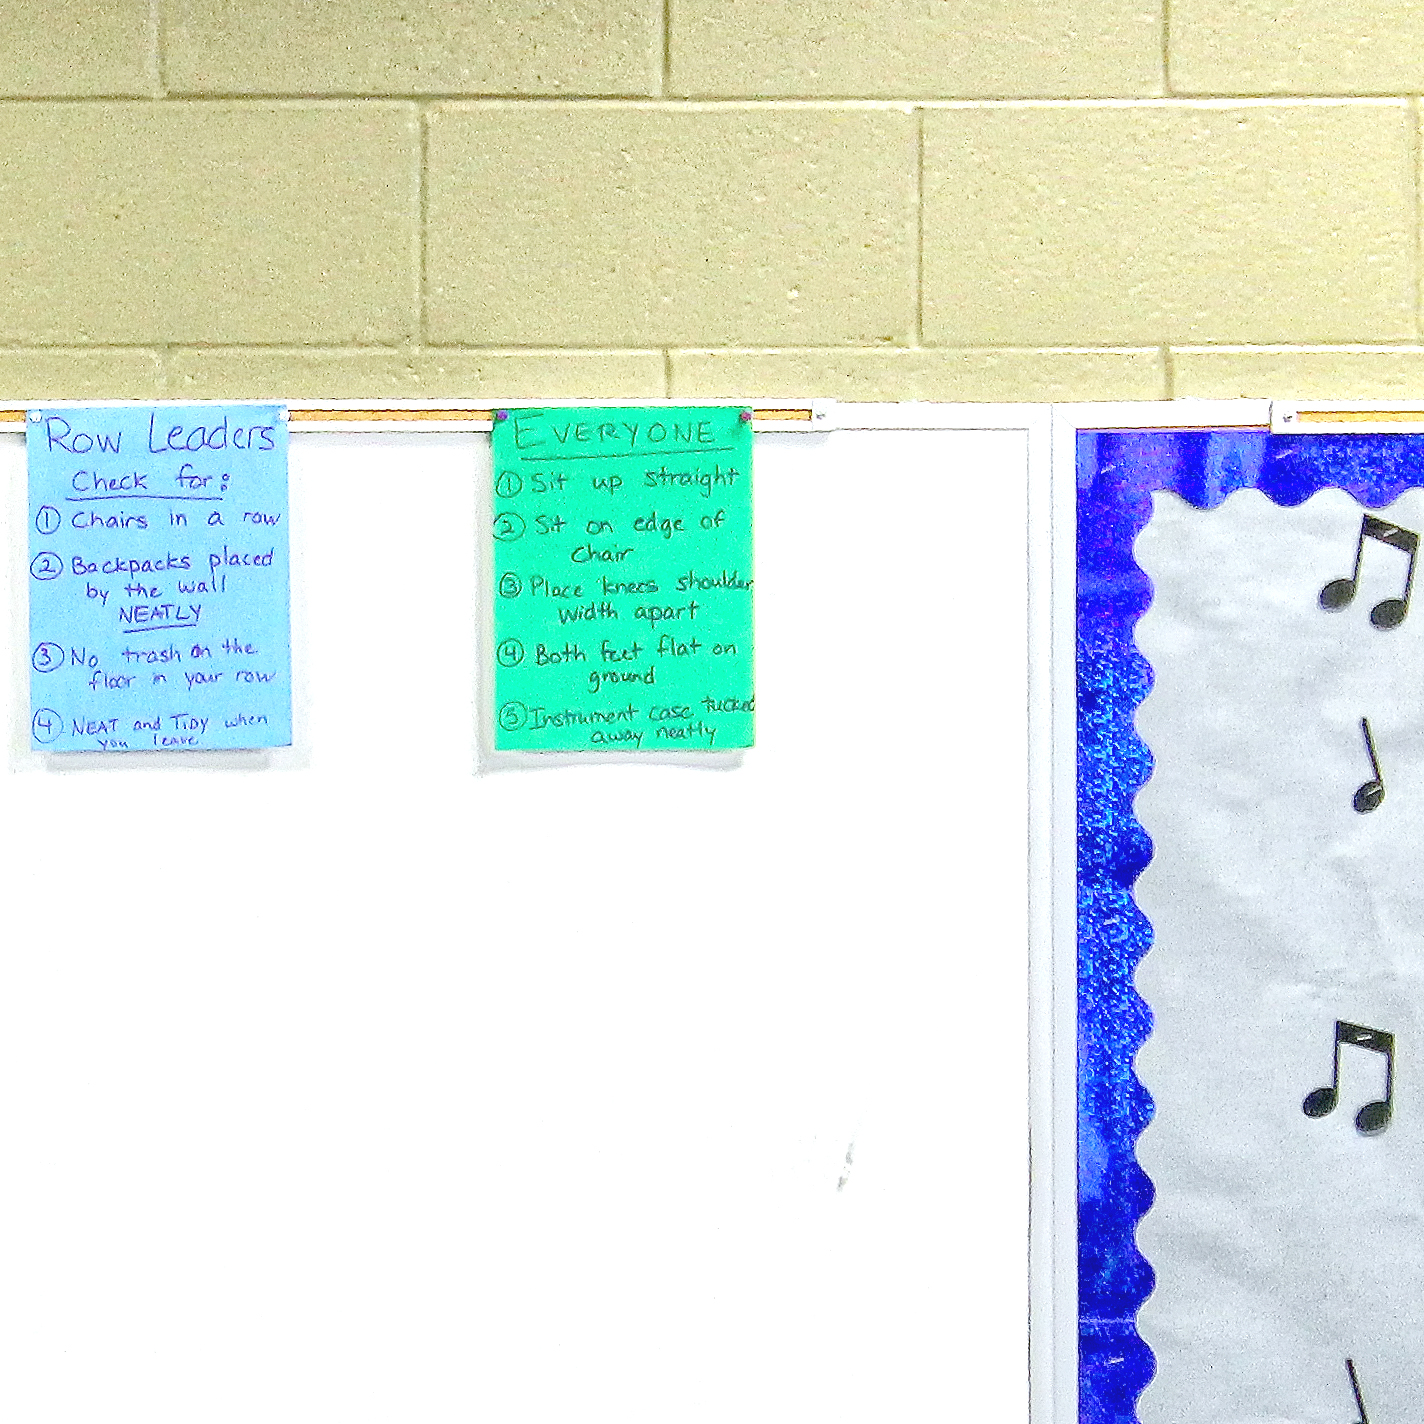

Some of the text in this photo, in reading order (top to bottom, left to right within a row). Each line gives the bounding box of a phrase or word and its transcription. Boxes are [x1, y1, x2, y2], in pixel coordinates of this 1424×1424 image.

[45, 411, 275, 454] Row Leaders
[514, 412, 717, 450] EVERYONE
[72, 470, 148, 492] Check
[531, 473, 569, 493] Sit
[592, 476, 624, 495] up
[71, 511, 149, 530] Chairs
[169, 509, 188, 527] in
[207, 511, 225, 527] a
[243, 511, 281, 526] row
[535, 514, 567, 535] Sit
[586, 521, 614, 535] on
[633, 511, 686, 539] edge
[701, 509, 726, 530] of
[71, 552, 191, 579] Backpacks
[209, 545, 275, 574] placed
[86, 575, 226, 605] by the wall
[530, 574, 585, 599] Place
[603, 575, 660, 596] knees
[675, 569, 755, 592] shoulder
[118, 603, 203, 625] NEATLY
[634, 600, 701, 629] apart
[70, 647, 99, 668] No
[121, 650, 182, 663] trash
[190, 644, 212, 658] on
[221, 638, 259, 655] the
[536, 643, 587, 666] Both
[602, 639, 643, 662] feet
[657, 634, 702, 658] flat
[713, 642, 739, 656] on
[88, 670, 137, 691] floor
[184, 672, 224, 691] your
[235, 671, 277, 683] row
[588, 666, 658, 694] ground
[72, 717, 119, 737] NEAT
[133, 716, 162, 731] and
[225, 713, 269, 728] when
[528, 703, 640, 730] Instrument
[97, 738, 129, 750] you
[590, 721, 717, 749] away neatly
